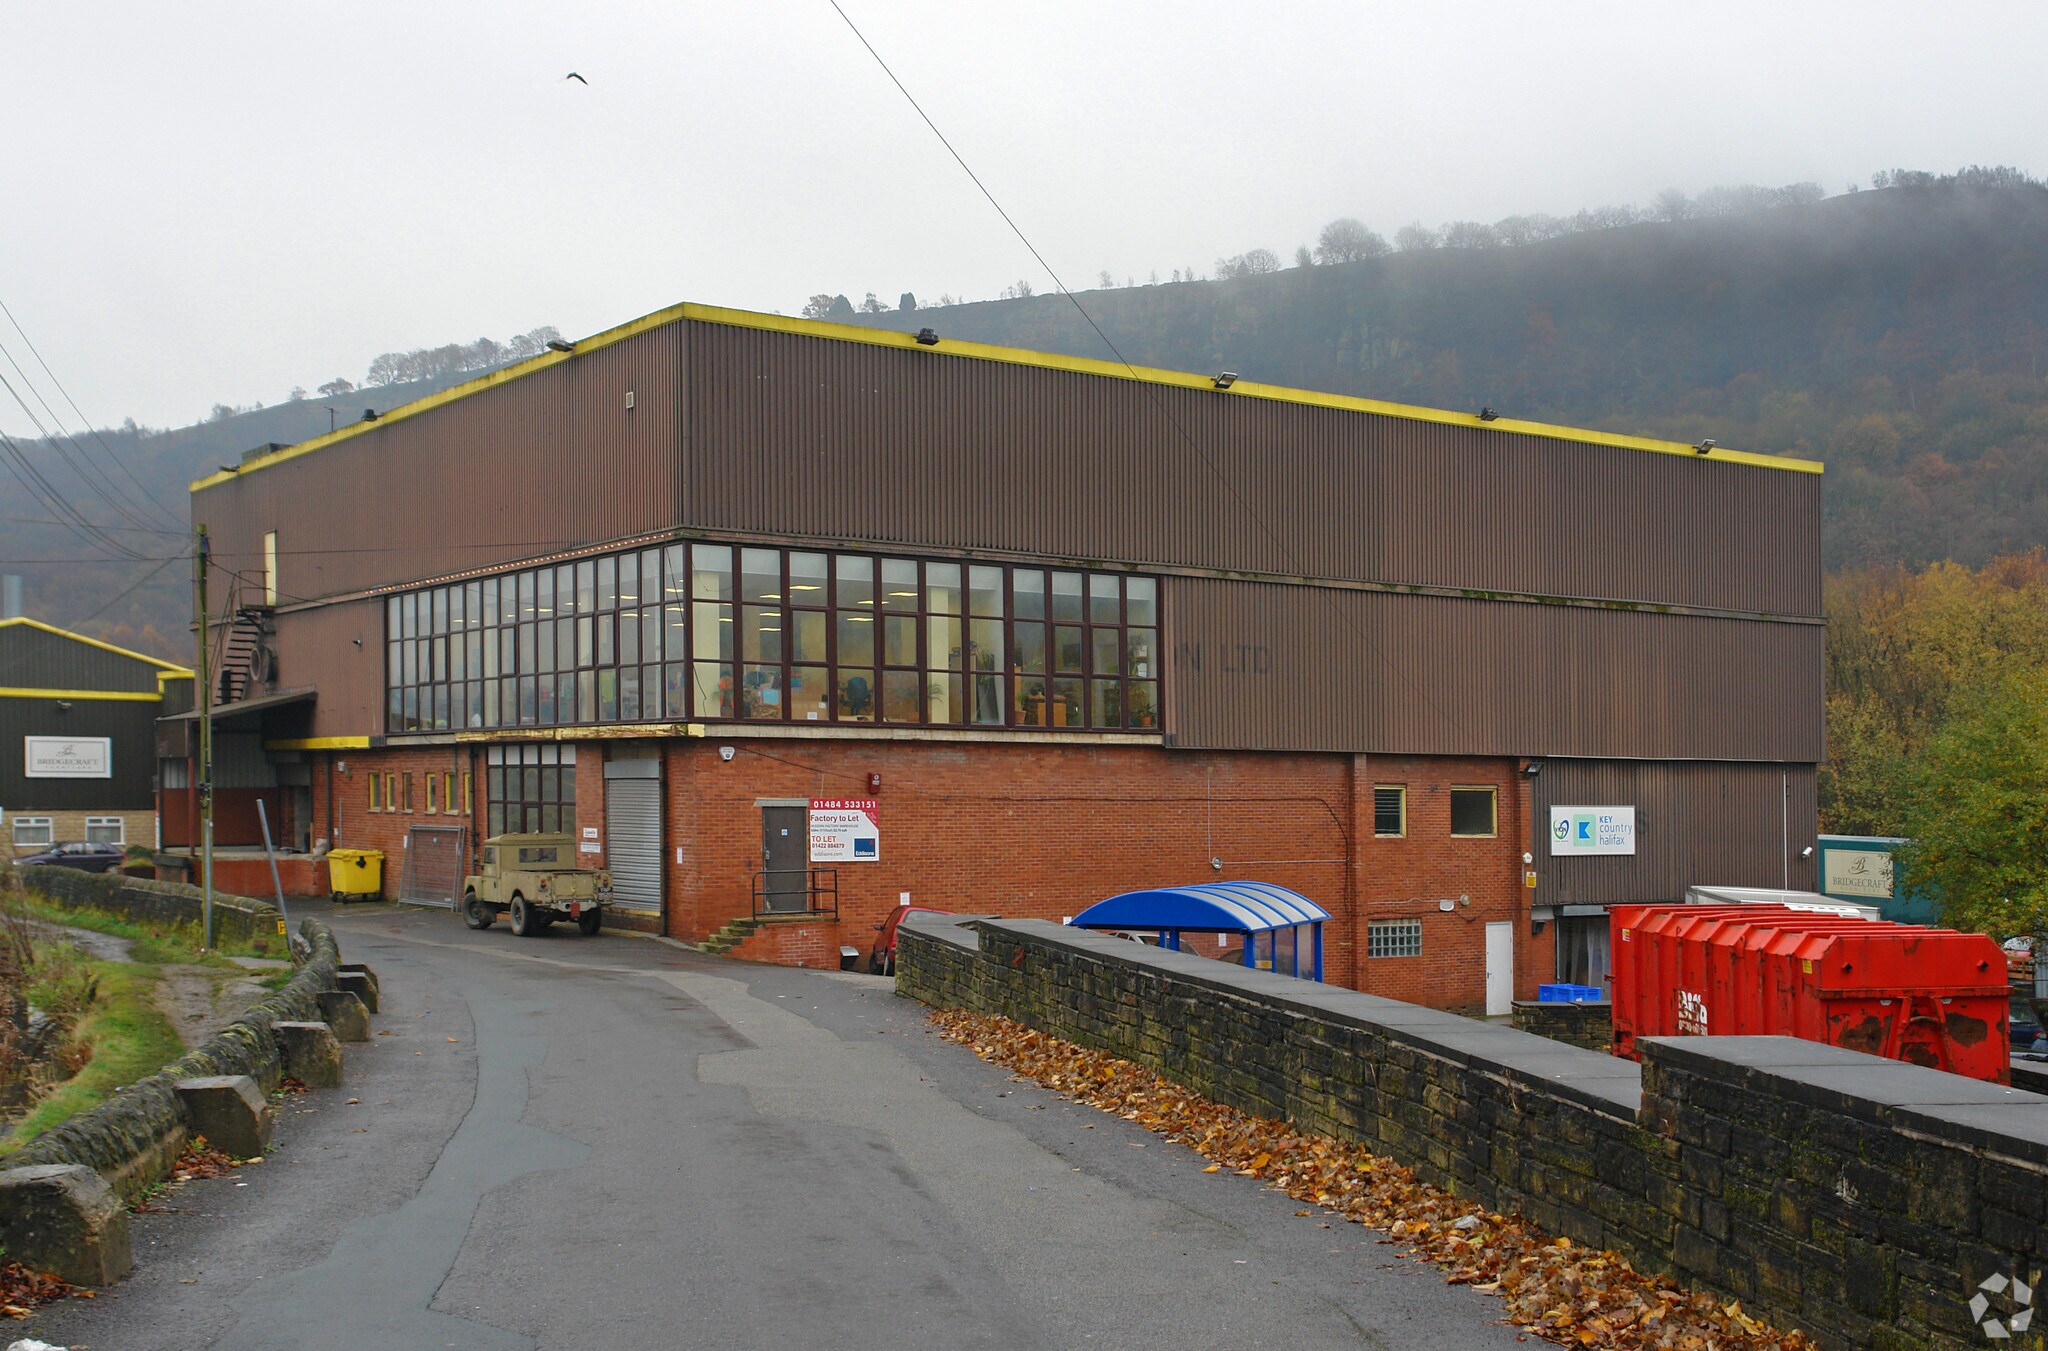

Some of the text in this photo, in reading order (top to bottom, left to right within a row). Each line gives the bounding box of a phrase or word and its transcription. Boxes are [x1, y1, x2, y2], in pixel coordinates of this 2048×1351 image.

[810, 815, 838, 823] Factory
[1599, 815, 1613, 823] KEY
[1599, 824, 1633, 835] country
[1599, 834, 1625, 846] halifax
[1832, 876, 1887, 888] BRIDGECRAFT
